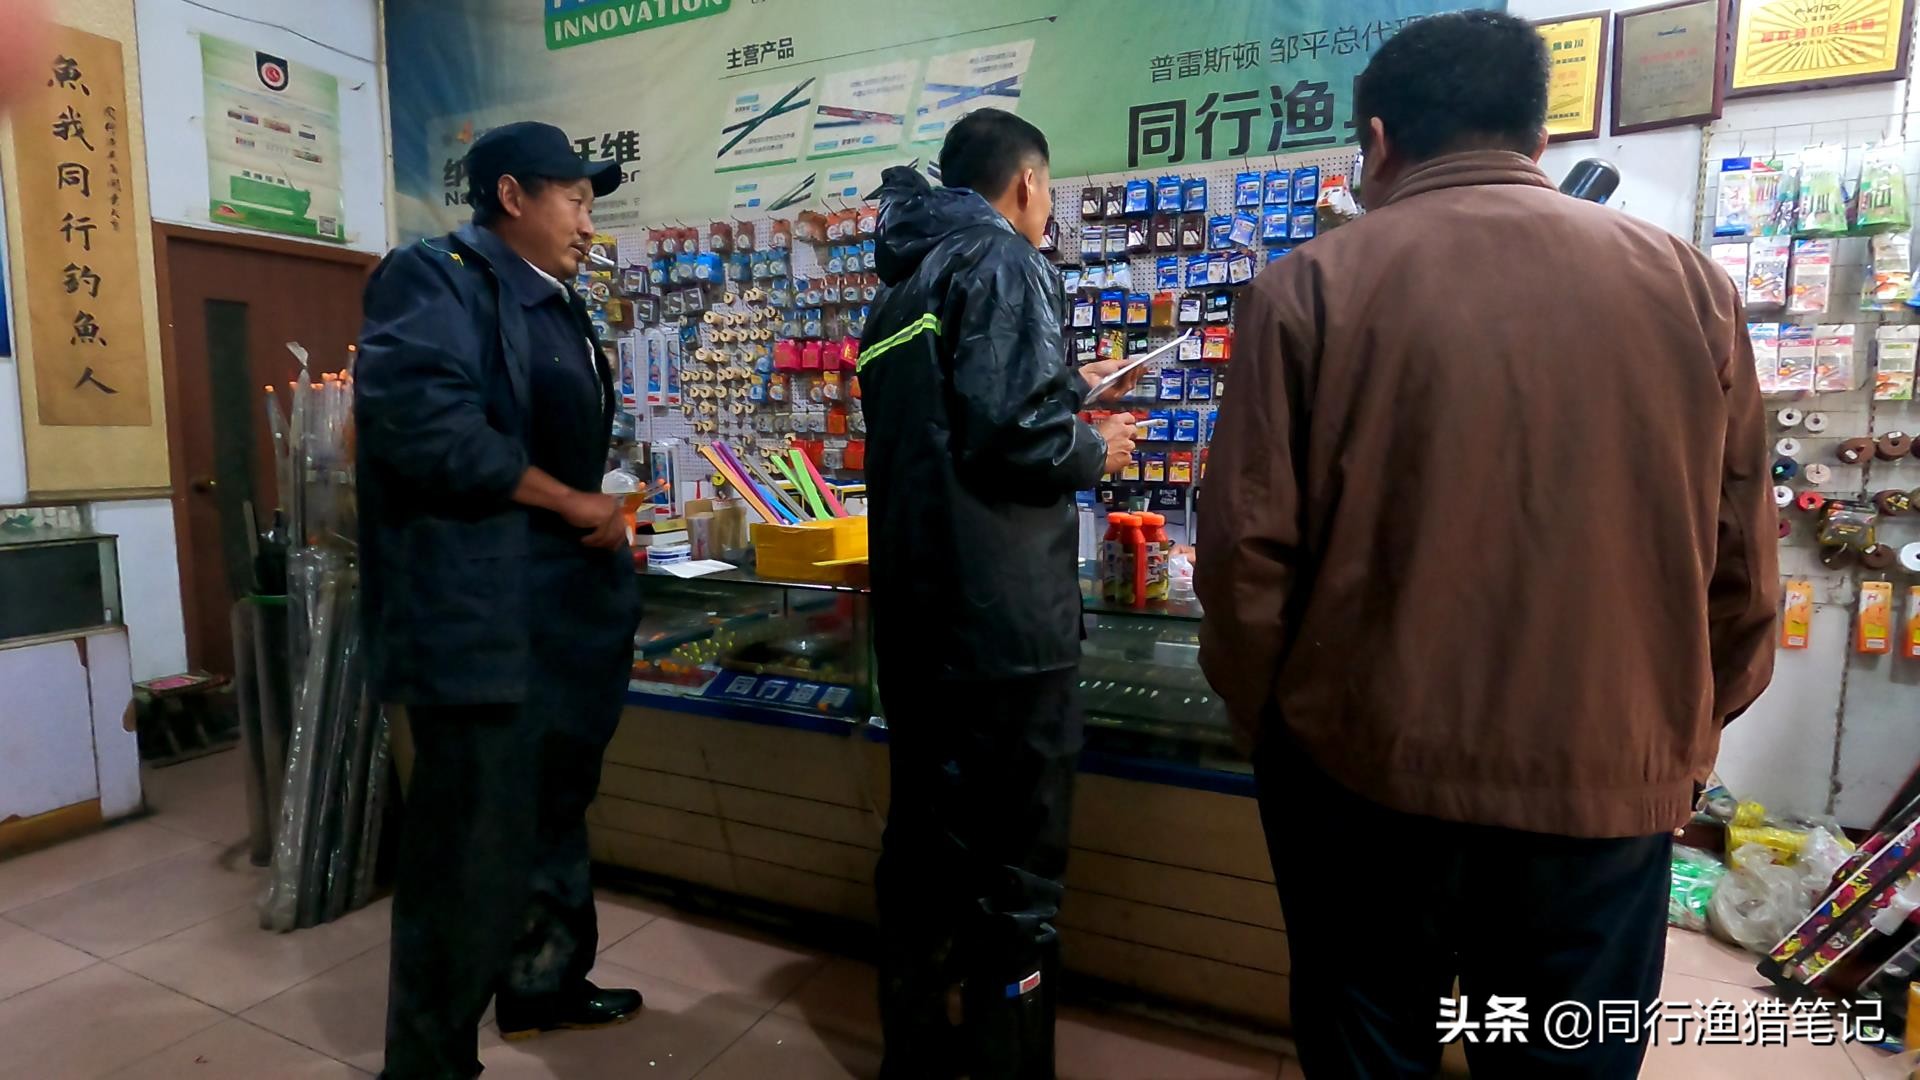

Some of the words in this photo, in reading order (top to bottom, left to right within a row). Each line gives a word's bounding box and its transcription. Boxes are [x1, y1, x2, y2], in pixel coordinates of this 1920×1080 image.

[726, 37, 795, 70] 主营产品
[1150, 41, 1261, 83] 普雷斯顿
[1127, 79, 1361, 168] 同行渔
